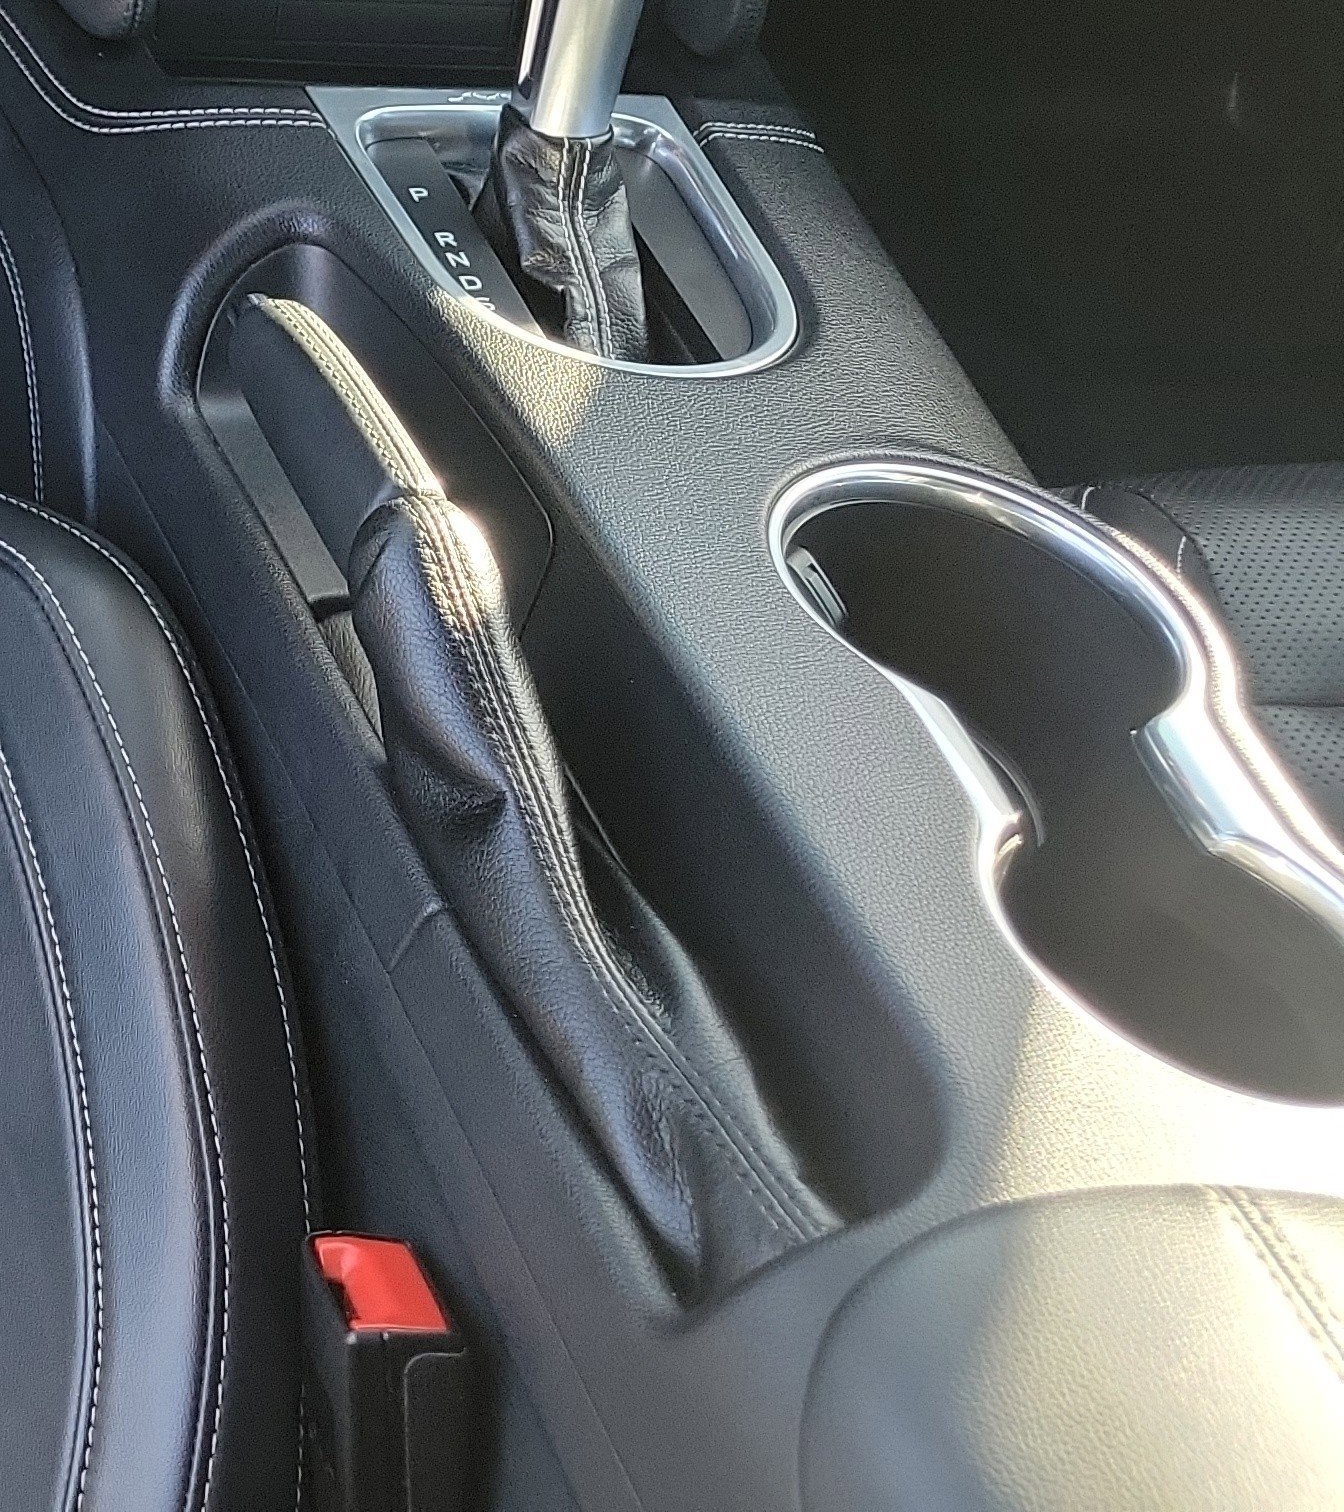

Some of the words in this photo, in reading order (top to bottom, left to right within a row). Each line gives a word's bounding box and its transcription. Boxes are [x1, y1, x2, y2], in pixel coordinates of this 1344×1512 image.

[408, 187, 429, 203] P
[433, 231, 458, 248] R
[445, 251, 471, 268] N
[458, 275, 483, 290] D
